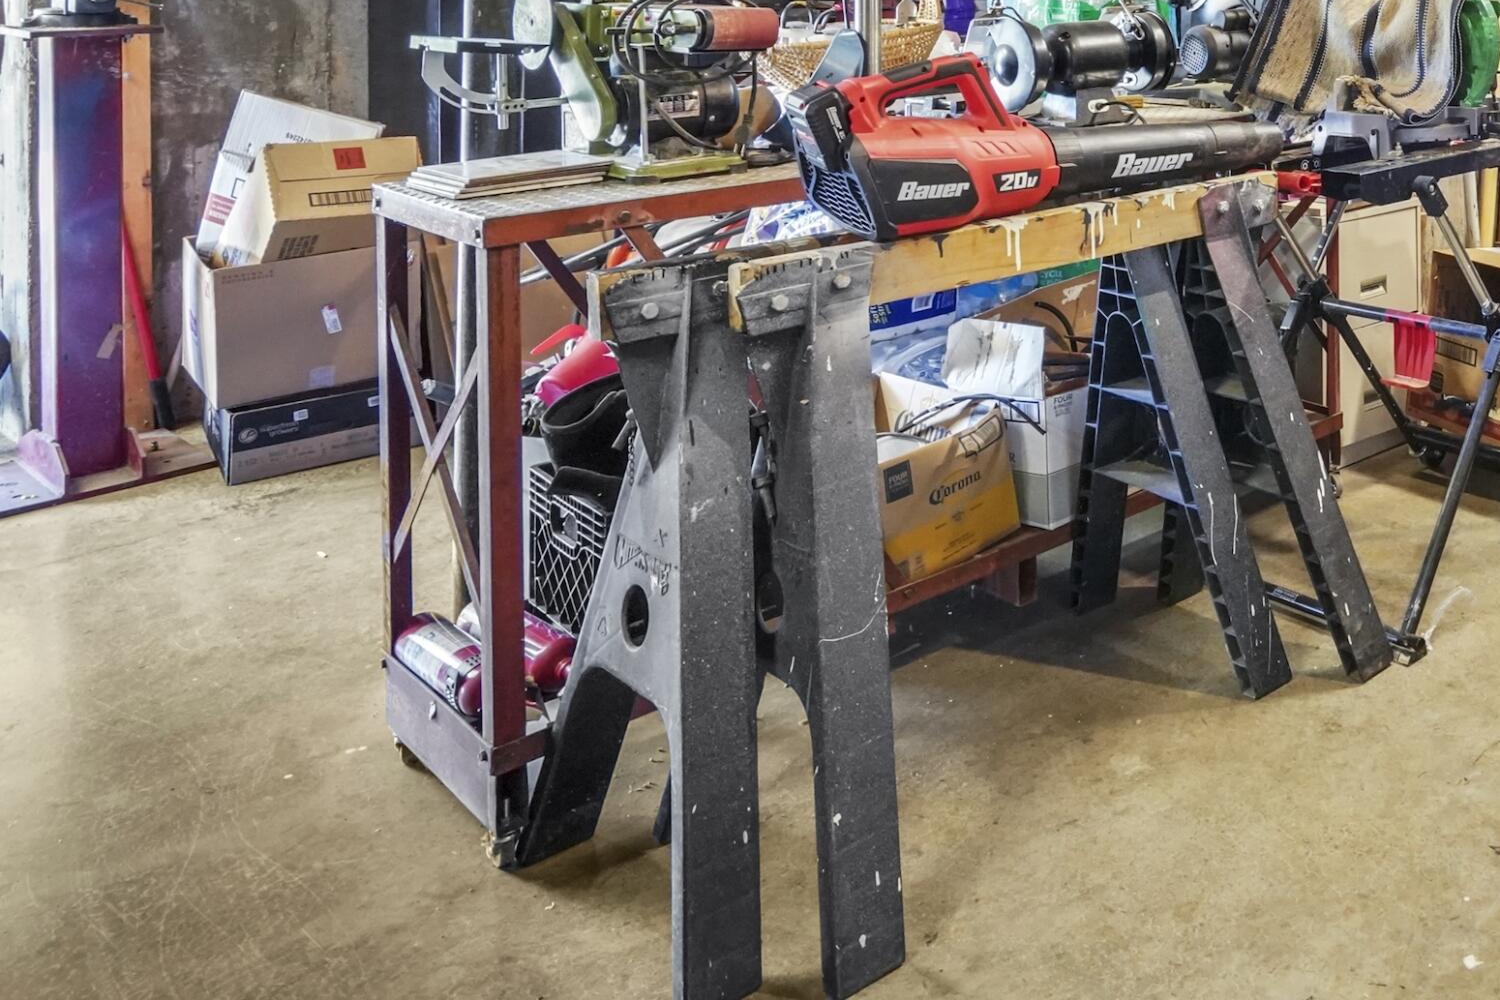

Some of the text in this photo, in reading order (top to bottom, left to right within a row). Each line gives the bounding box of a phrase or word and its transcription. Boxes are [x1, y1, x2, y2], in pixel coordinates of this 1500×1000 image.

[1111, 152, 1193, 178] Bauer
[897, 181, 970, 202] Bauer
[929, 471, 982, 505] Corona
